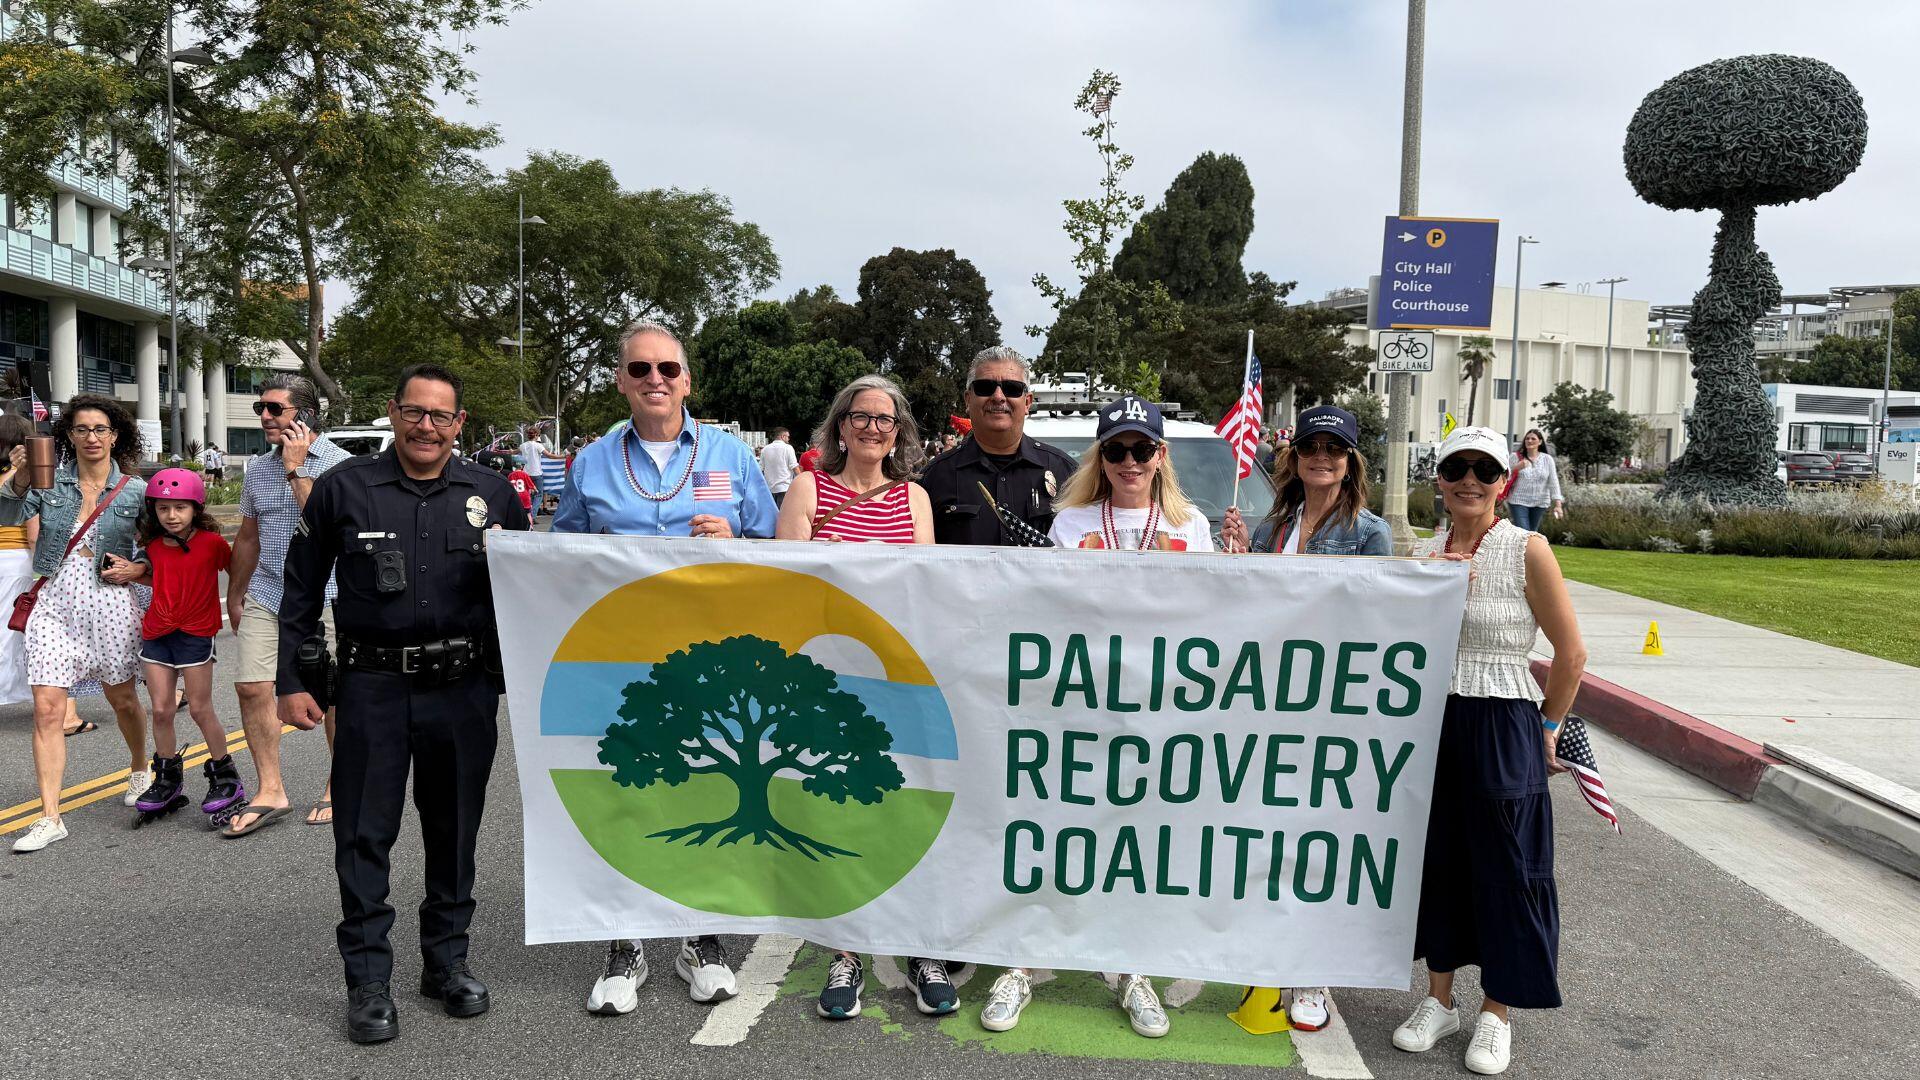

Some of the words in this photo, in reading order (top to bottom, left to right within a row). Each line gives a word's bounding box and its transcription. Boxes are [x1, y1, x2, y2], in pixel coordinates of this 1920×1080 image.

[1431, 232, 1442, 244] P
[1395, 261, 1421, 276] City
[1425, 262, 1451, 274] Hall
[1393, 280, 1433, 292] Police
[1392, 298, 1469, 312] Courthouse
[1382, 361, 1402, 370] BIKE
[1406, 361, 1428, 370] LANE
[1124, 396, 1148, 422] LA
[1309, 414, 1344, 424] PALISADES
[1887, 450, 1908, 459] EVgo
[1006, 632, 1427, 717] PALISADES
[1006, 728, 1415, 813] RECOVERY
[1003, 819, 1399, 909] COALITION
